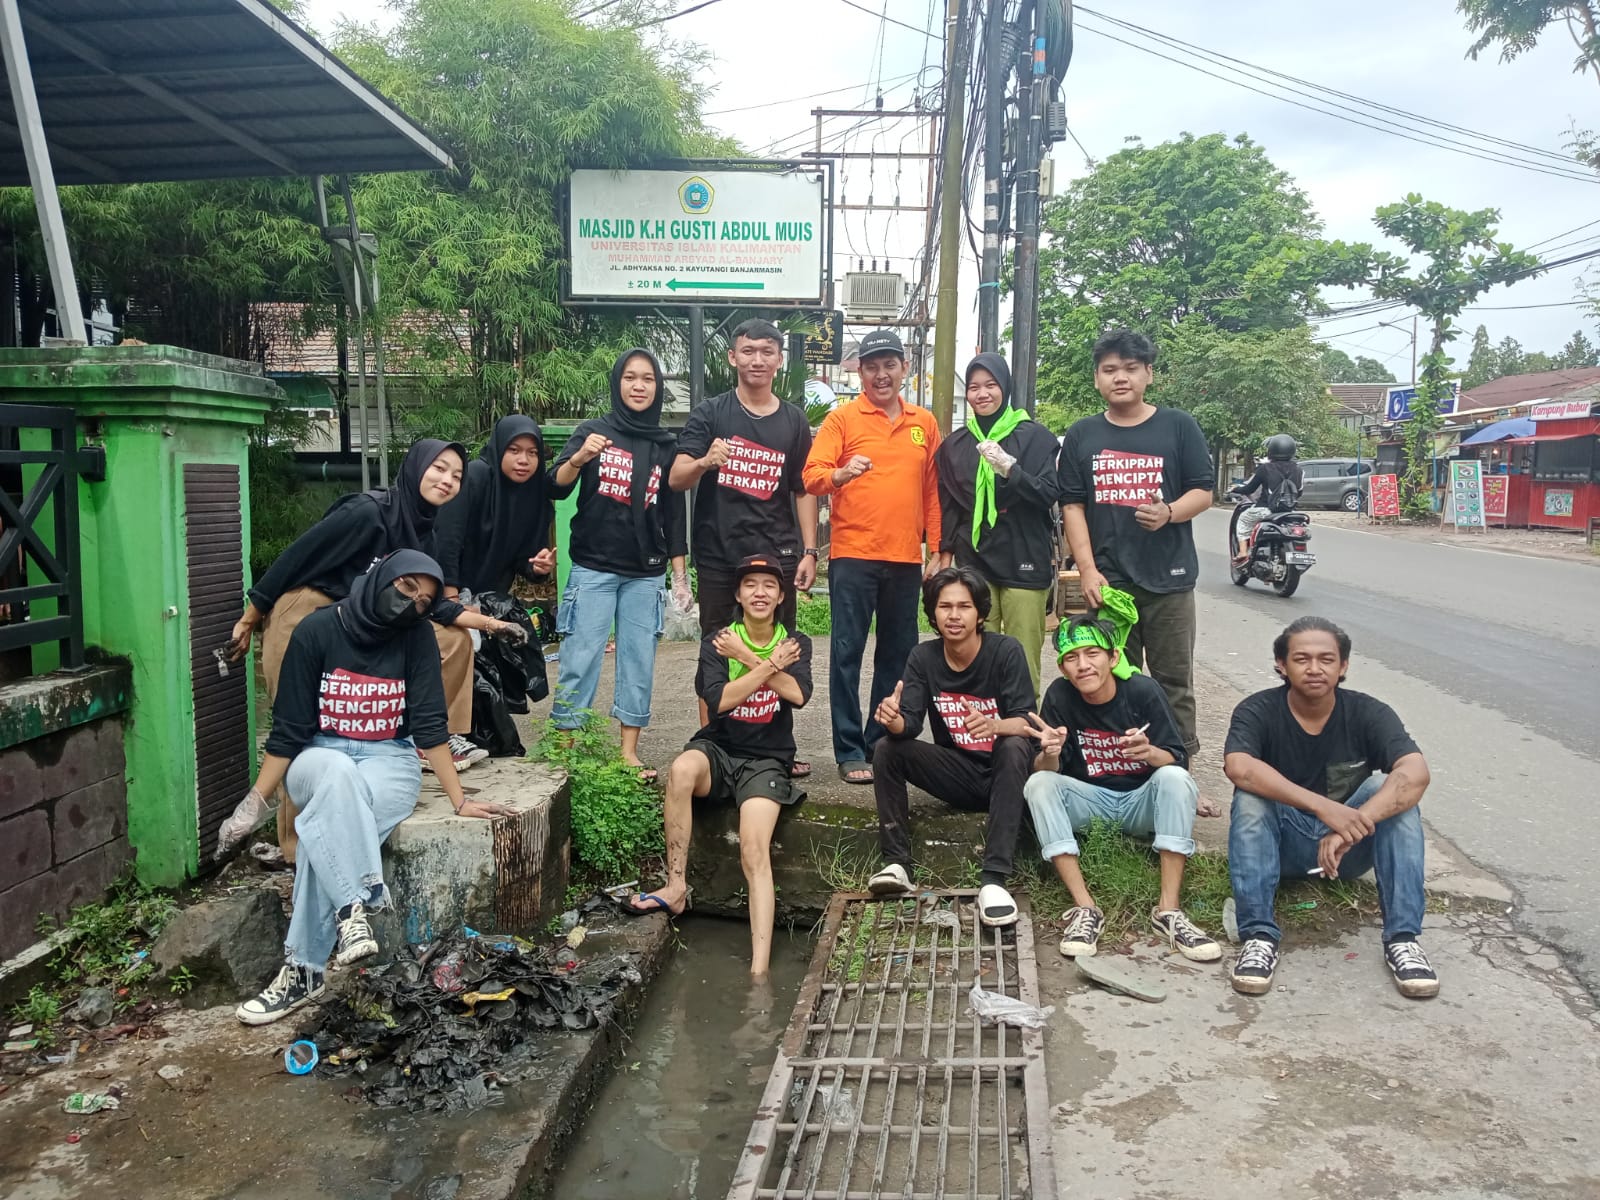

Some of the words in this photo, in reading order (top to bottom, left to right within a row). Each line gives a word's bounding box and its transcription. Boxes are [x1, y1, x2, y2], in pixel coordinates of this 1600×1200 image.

[579, 219, 635, 239] MASJID
[640, 220, 665, 239] K.H
[671, 220, 716, 240] GUSTI
[720, 221, 770, 241] ABDUL
[775, 222, 813, 242] MUIS
[591, 241, 674, 251] UNIVERSITAS
[678, 243, 716, 252] ISLAM
[720, 244, 801, 254] KALIMANTAN
[608, 254, 671, 263] MUHAMMAD
[719, 256, 783, 265] AL-BANJARY
[637, 280, 650, 288] 20
[1532, 404, 1566, 417] Kampung
[729, 445, 786, 464] ERKIPRAH
[1092, 458, 1164, 470] BERKIPRAH
[1092, 472, 1163, 486] MENCIPTA
[320, 680, 406, 696] BERKIPRAH
[319, 697, 406, 714] MENCIPTA
[729, 701, 780, 718] ERKARYA
[320, 715, 404, 732] BERKARYA
